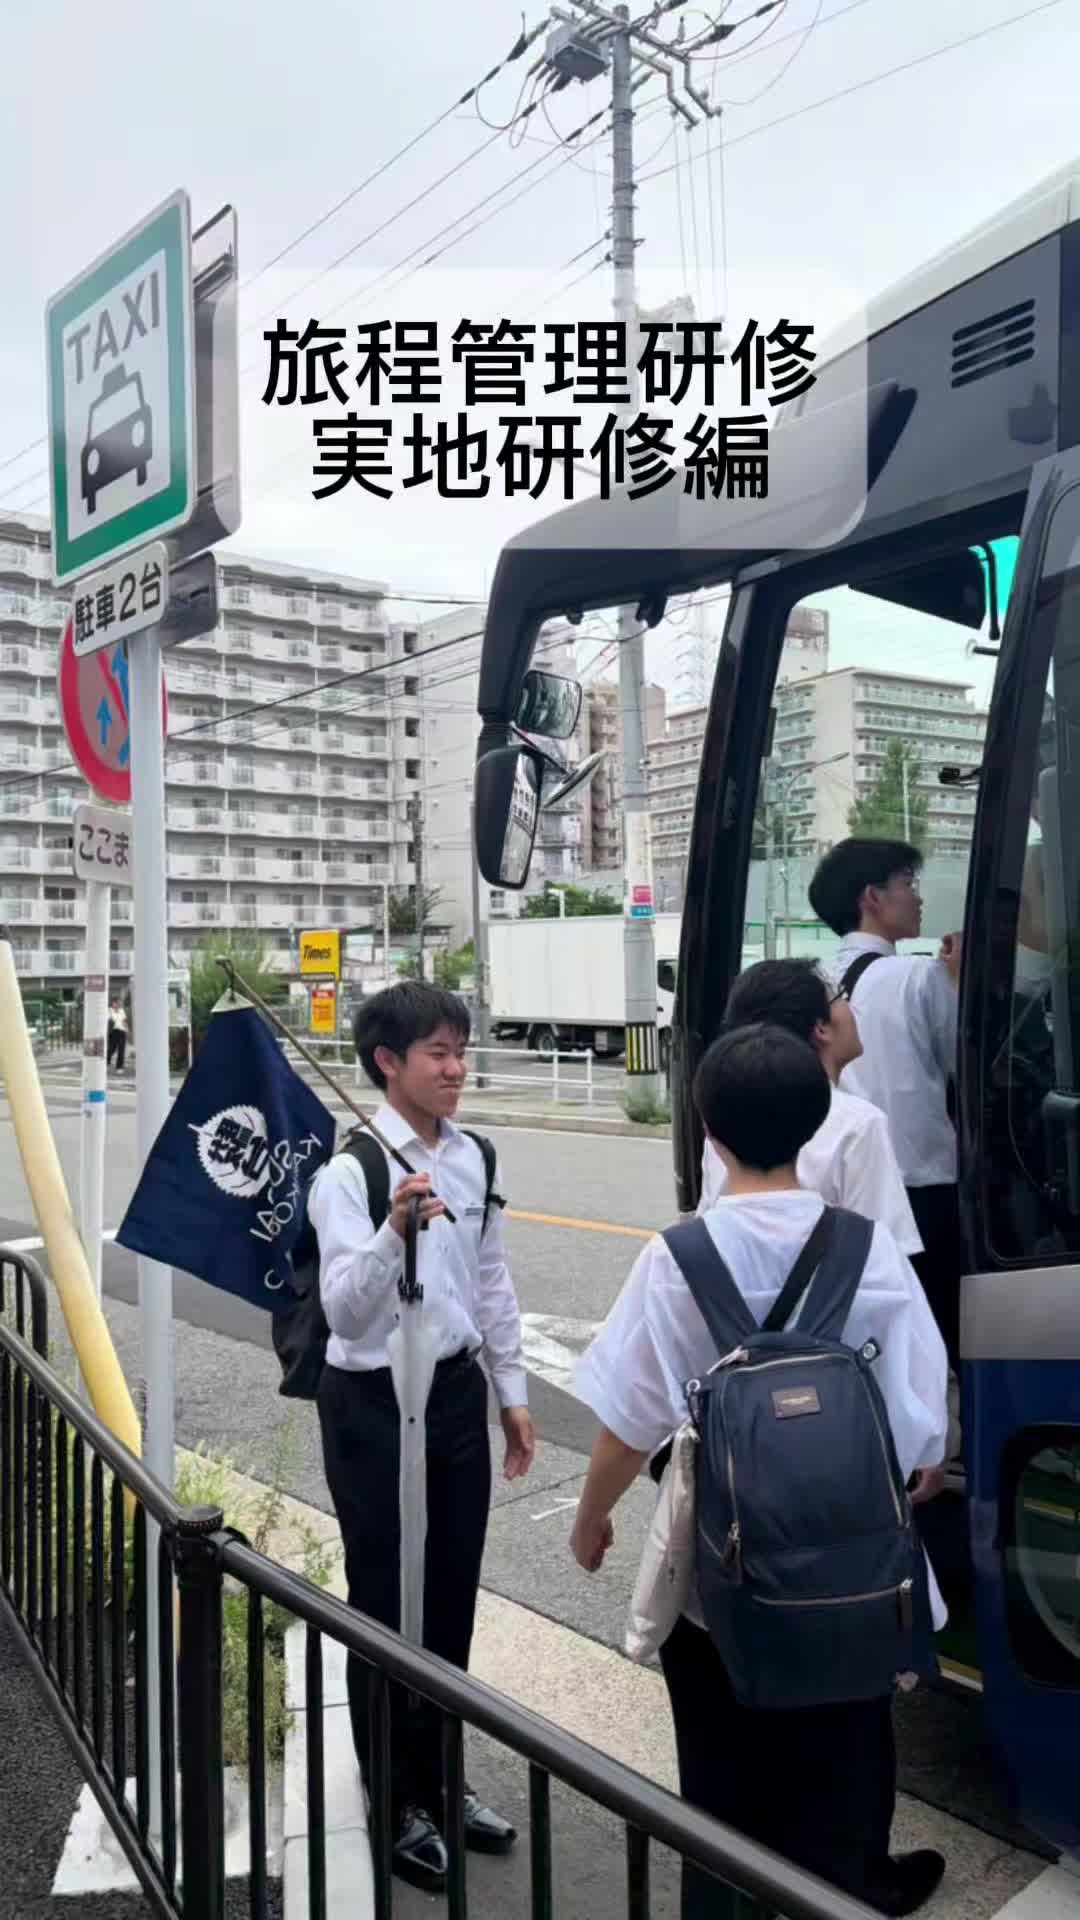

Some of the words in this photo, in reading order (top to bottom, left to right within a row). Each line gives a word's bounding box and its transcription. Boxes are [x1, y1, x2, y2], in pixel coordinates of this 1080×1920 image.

[67, 271, 160, 385] TAXI
[74, 561, 161, 643] 駐車2台
[303, 944, 332, 961] Times
